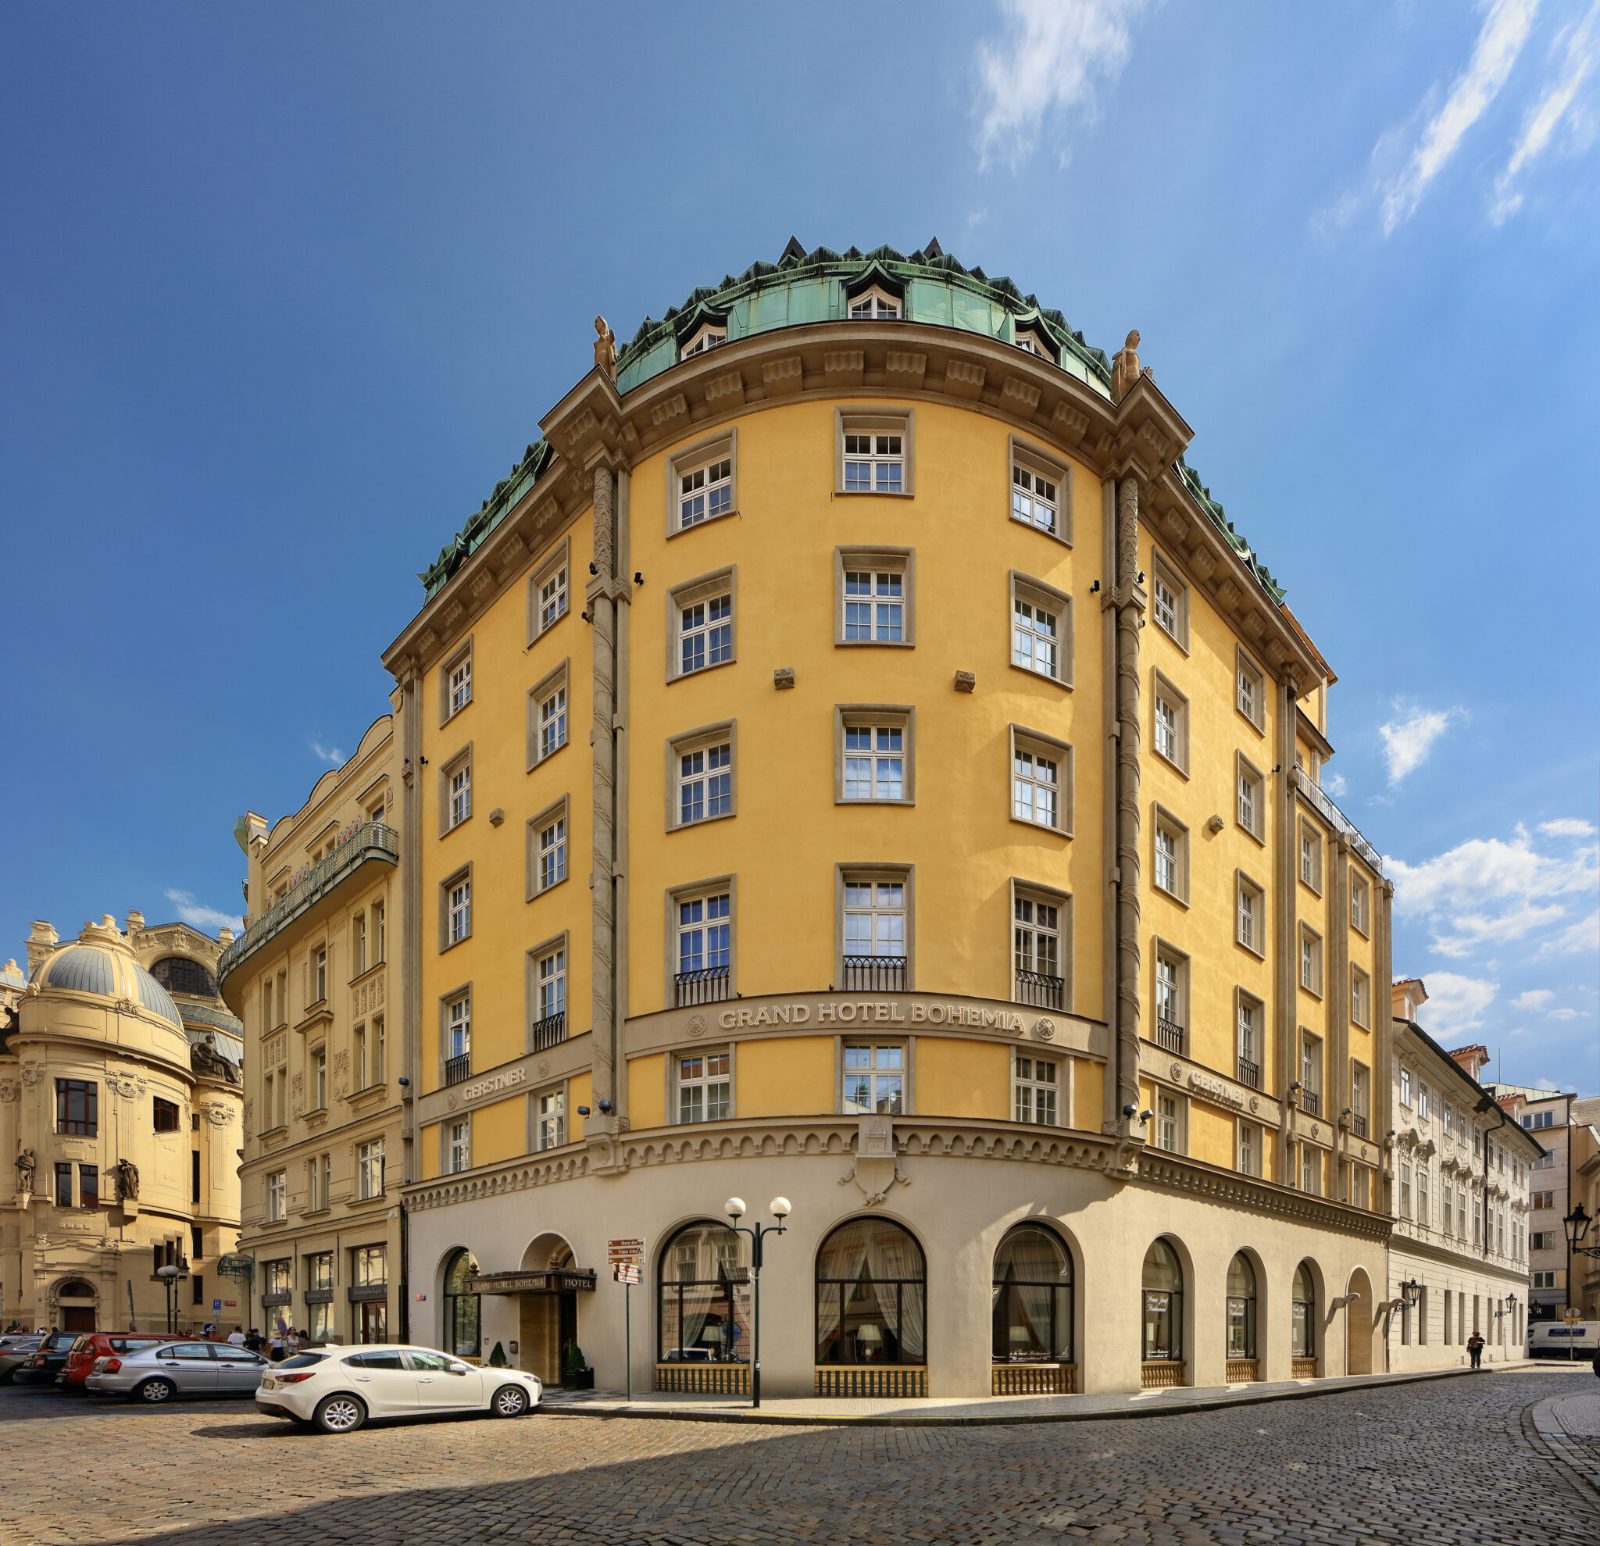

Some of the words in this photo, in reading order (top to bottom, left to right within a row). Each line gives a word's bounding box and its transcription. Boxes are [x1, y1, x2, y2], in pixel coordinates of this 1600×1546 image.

[718, 1003, 810, 1029] GRAND
[817, 1002, 905, 1022] HOTEL
[911, 1003, 1025, 1033] BOHEMIA
[463, 1066, 527, 1101] GERSTNER
[1190, 1070, 1245, 1105] GERSTNER
[493, 1281, 513, 1289] HOTEL
[514, 1278, 545, 1289] BOHEMIA
[564, 1278, 593, 1288] HOTEL
